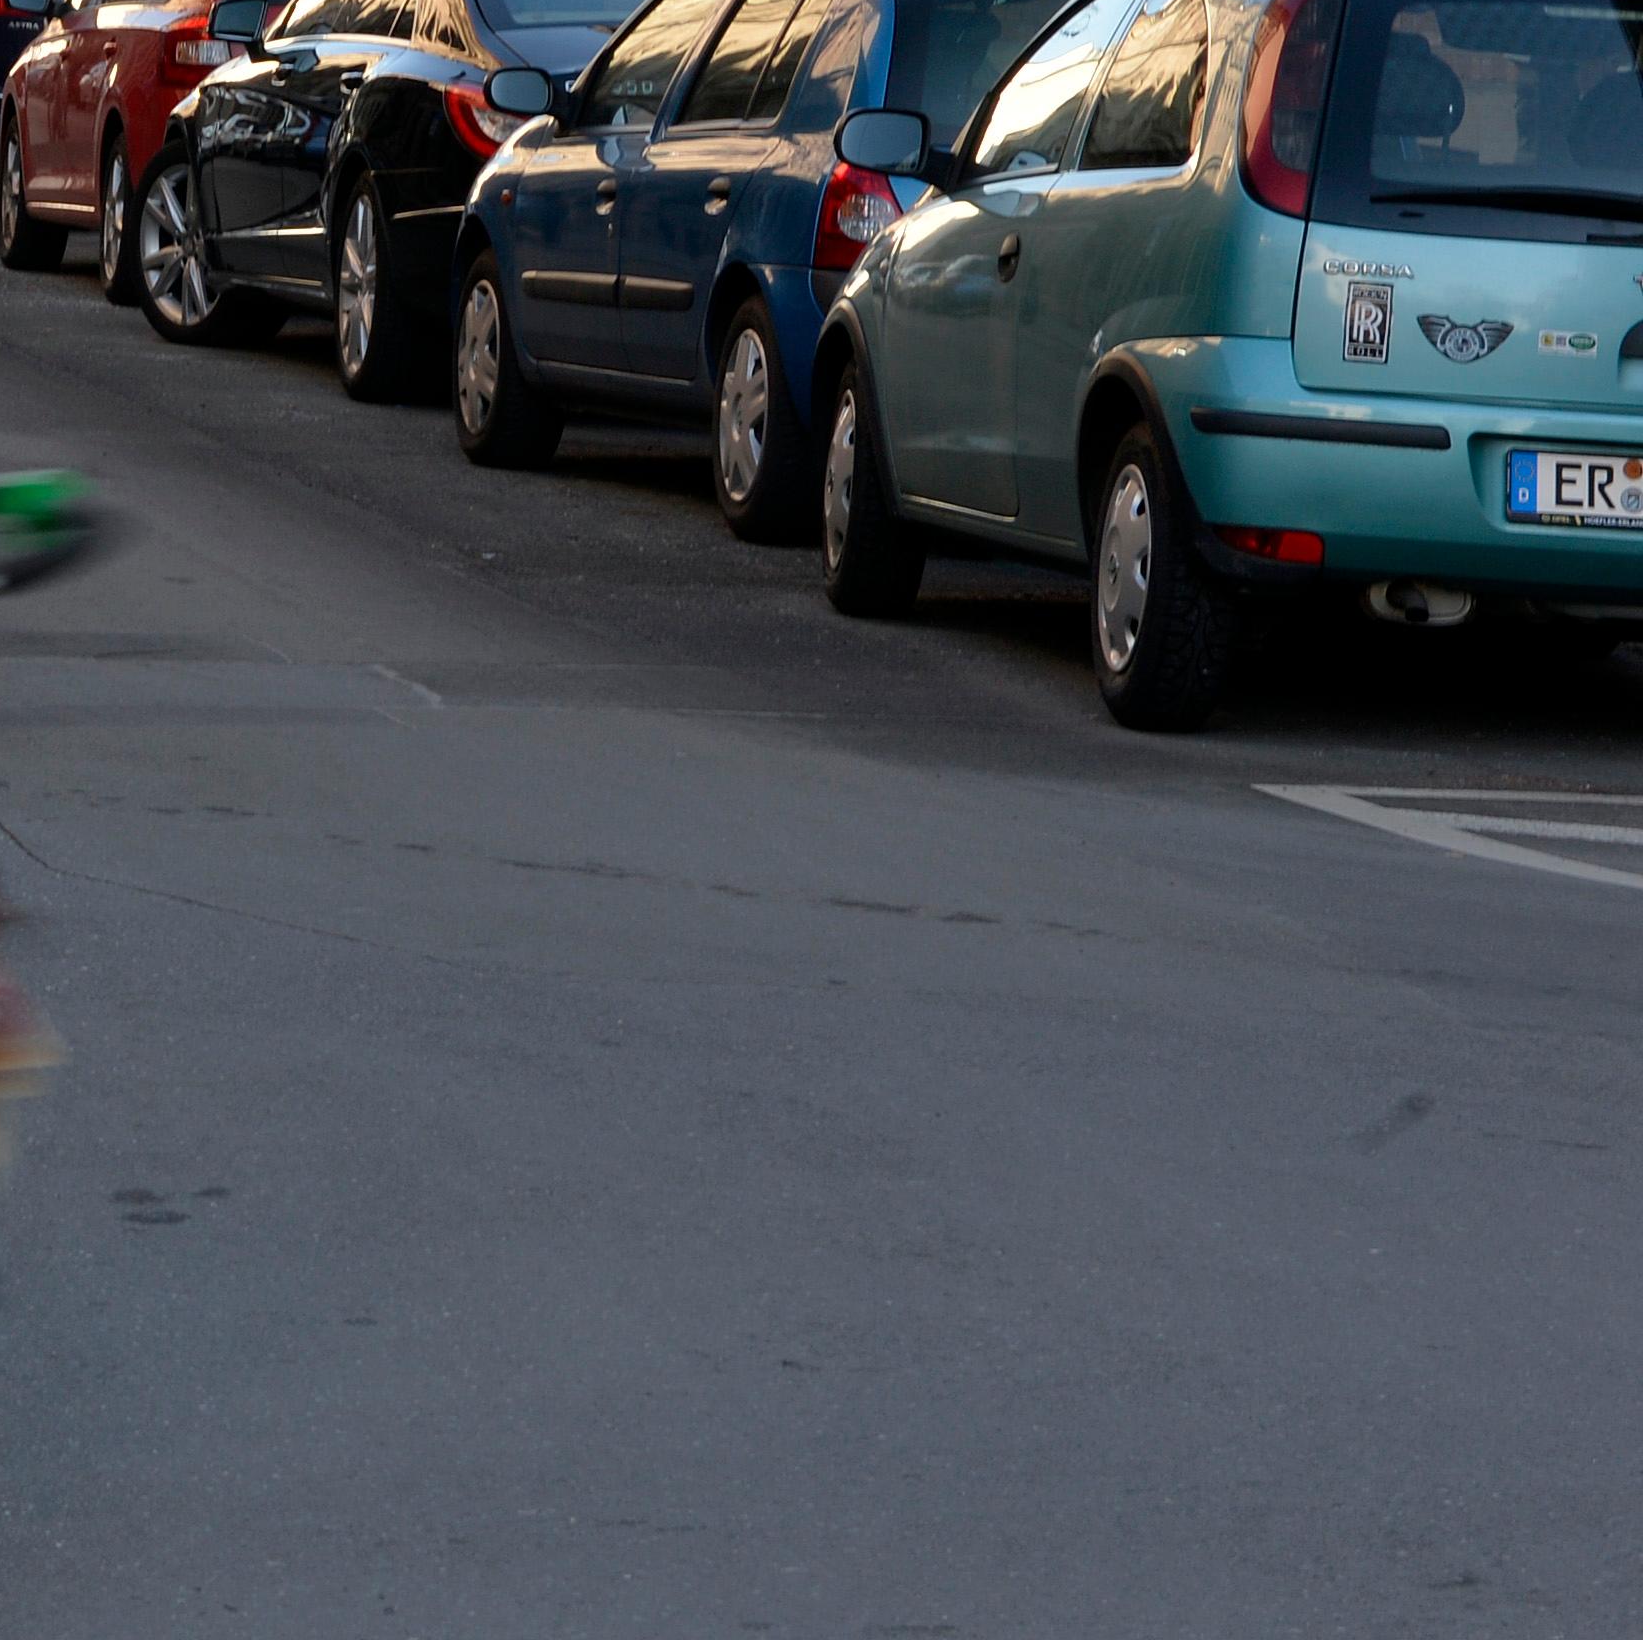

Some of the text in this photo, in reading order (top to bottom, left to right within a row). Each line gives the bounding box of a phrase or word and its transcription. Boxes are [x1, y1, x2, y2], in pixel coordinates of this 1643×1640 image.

[1324, 260, 1413, 279] CORSA
[1556, 463, 1615, 508] ER
[1519, 488, 1529, 504] D
